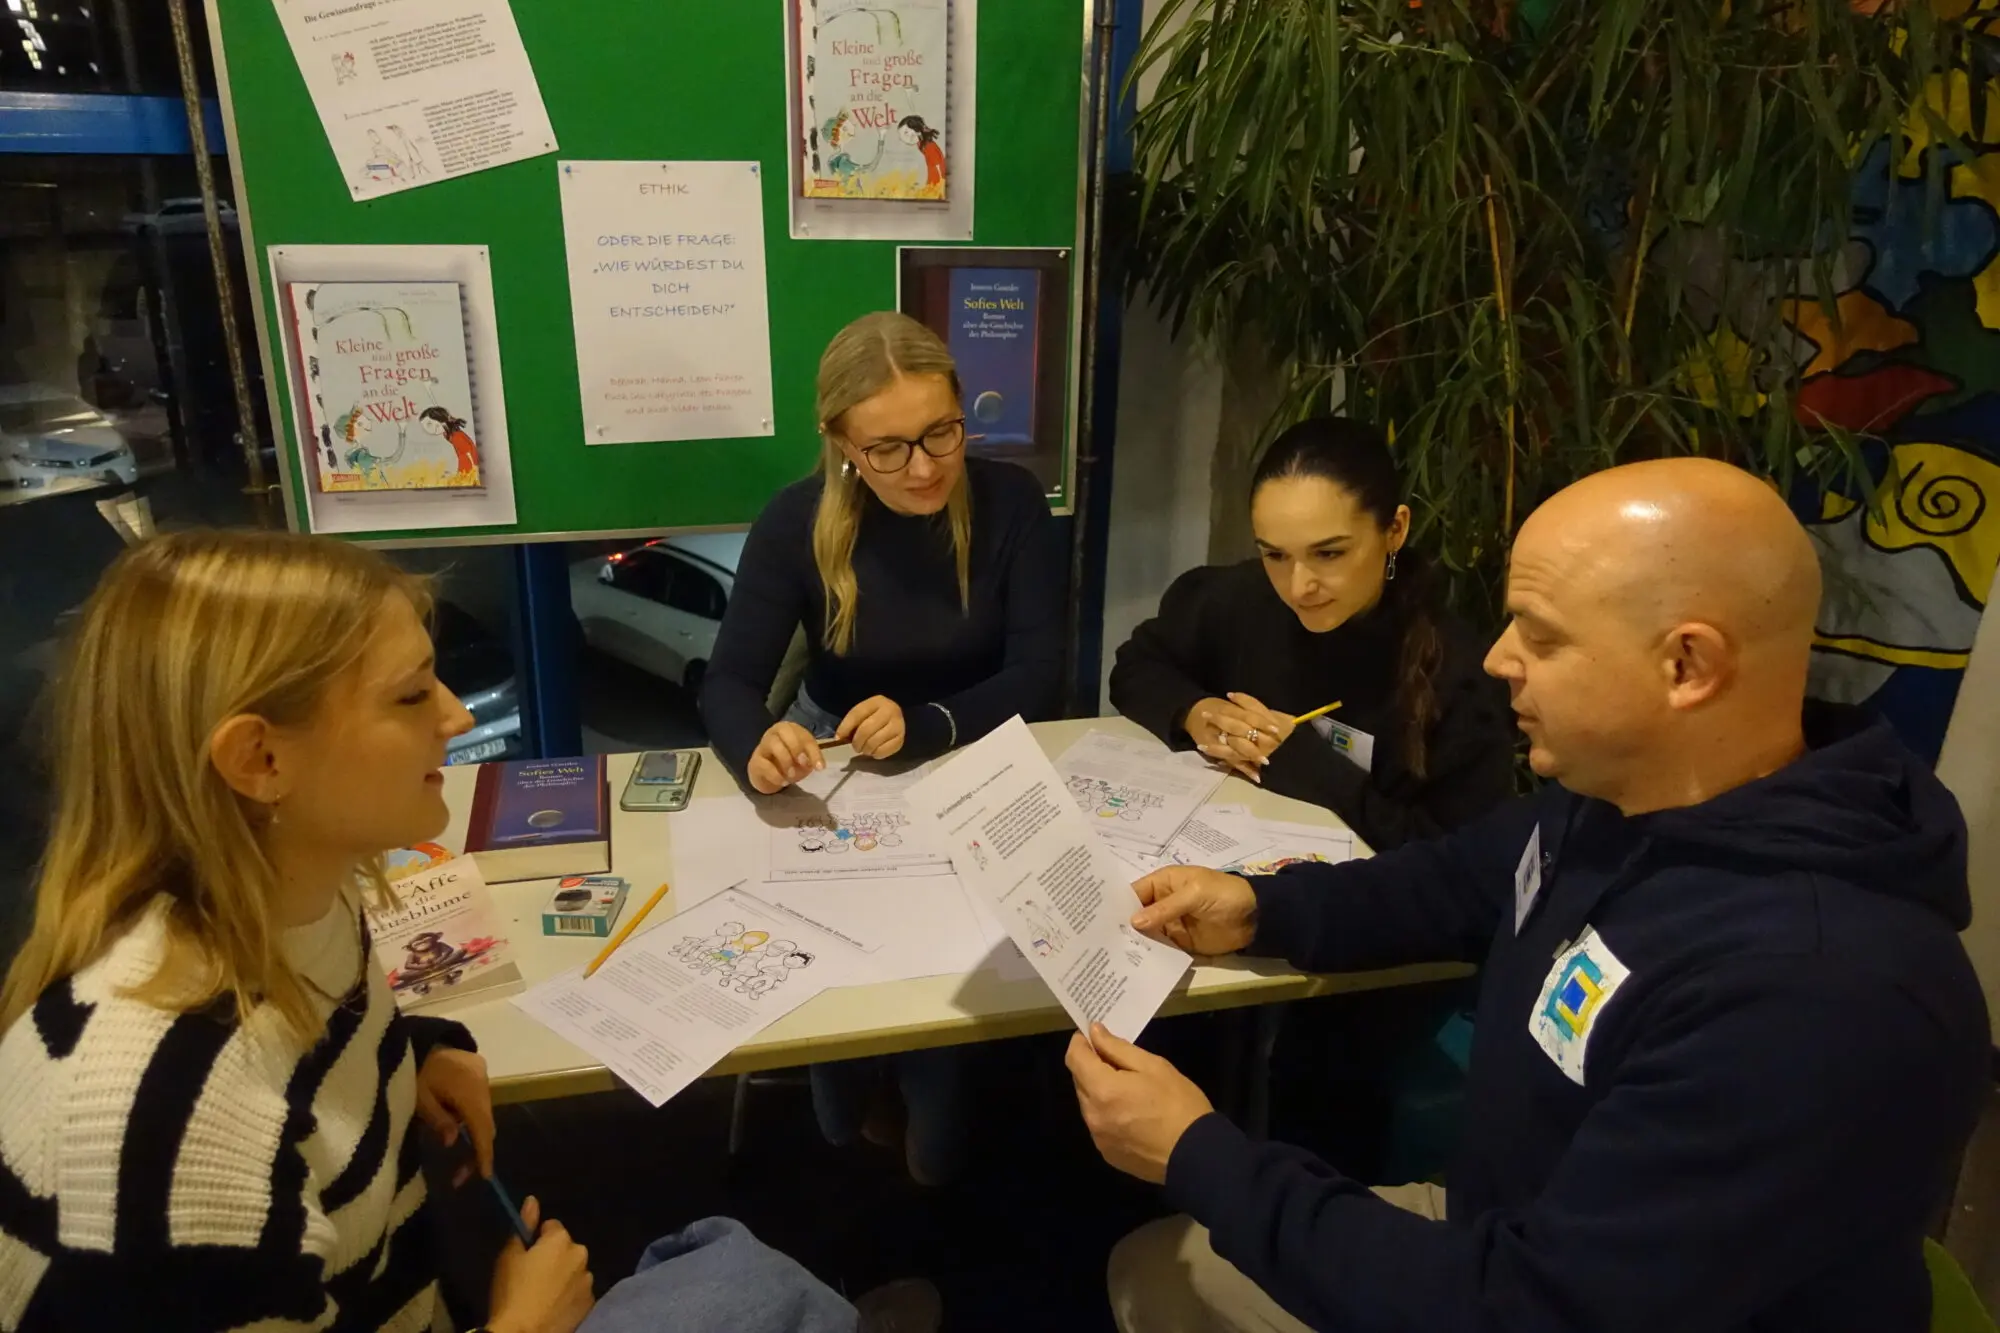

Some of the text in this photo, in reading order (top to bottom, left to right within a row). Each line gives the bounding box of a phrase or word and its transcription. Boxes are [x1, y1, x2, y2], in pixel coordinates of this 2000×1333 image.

[832, 40, 874, 55] Kleine
[884, 50, 924, 71] große
[850, 69, 914, 92] Fragen
[850, 89, 883, 101] an die
[852, 103, 898, 129] Welt
[639, 183, 690, 195] ETHIK
[597, 234, 736, 247] ODER DIE FRAGE:
[635, 257, 721, 272] WÜRDEST
[722, 259, 745, 270] DU
[652, 283, 690, 294] DICH
[963, 297, 1024, 311] Sofies Welt
[335, 338, 383, 355] Kleine
[395, 343, 440, 367] große
[359, 365, 431, 388] Fragen
[363, 385, 398, 398] an die
[366, 397, 419, 423] Welt
[410, 873, 459, 898] Affe
[415, 894, 437, 906] die
